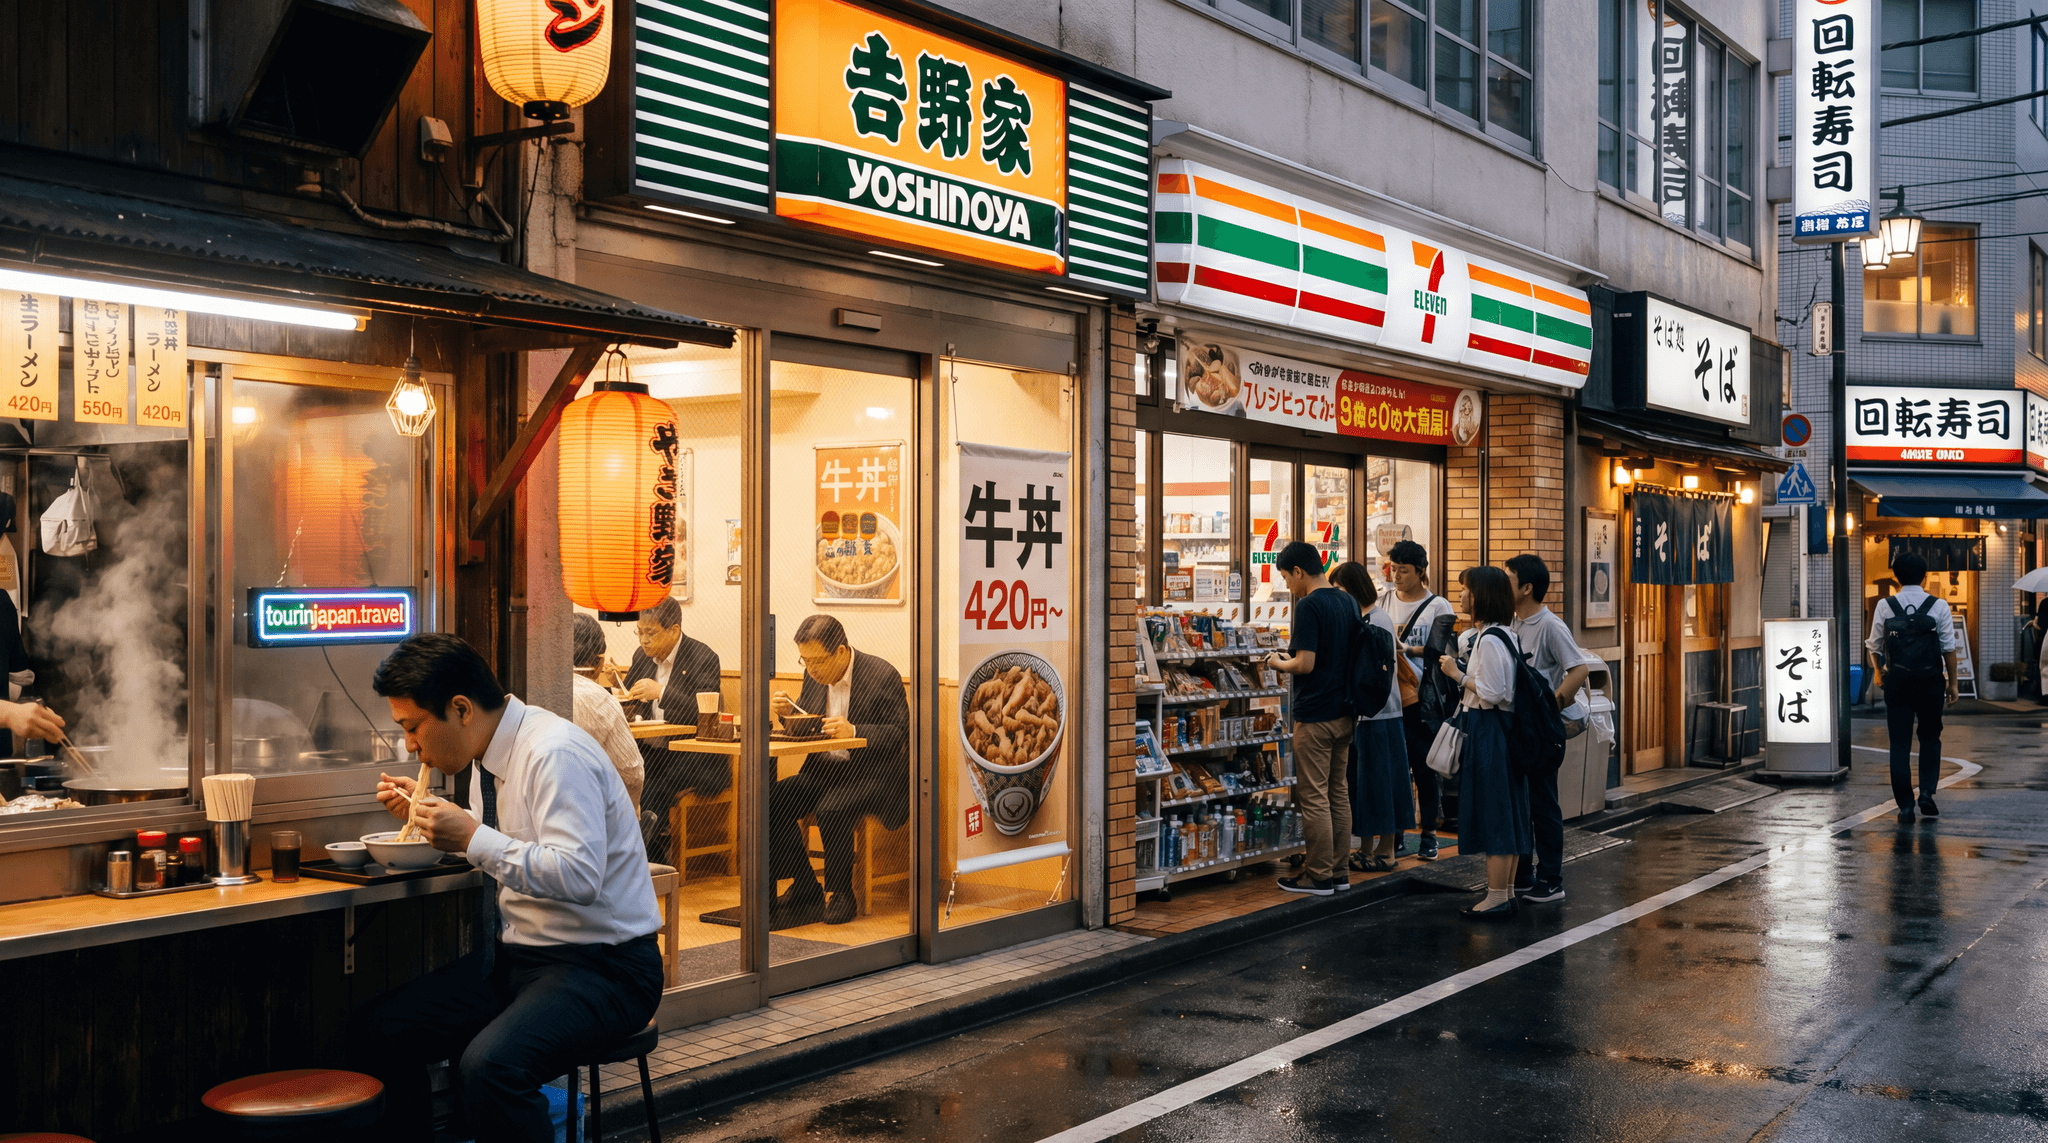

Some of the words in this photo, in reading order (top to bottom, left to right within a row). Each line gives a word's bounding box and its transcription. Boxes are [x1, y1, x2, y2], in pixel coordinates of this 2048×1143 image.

[1811, 14, 1855, 192] 回転寿司
[848, 158, 1031, 241] YOSHINOYA
[20, 293, 39, 388] 生ラーメン
[147, 332, 161, 392] ラーメン
[1694, 337, 1738, 404] そば
[7, 395, 52, 413] 420円
[83, 400, 122, 418] 550円
[143, 405, 181, 422] 420円
[1855, 397, 2010, 440] 回転寿司
[820, 457, 887, 503] 牛丼
[964, 481, 1063, 570] 牛丼
[1654, 520, 1712, 563] そば
[266, 603, 405, 631] tourinjapan.travel
[1775, 646, 1812, 724] そば
